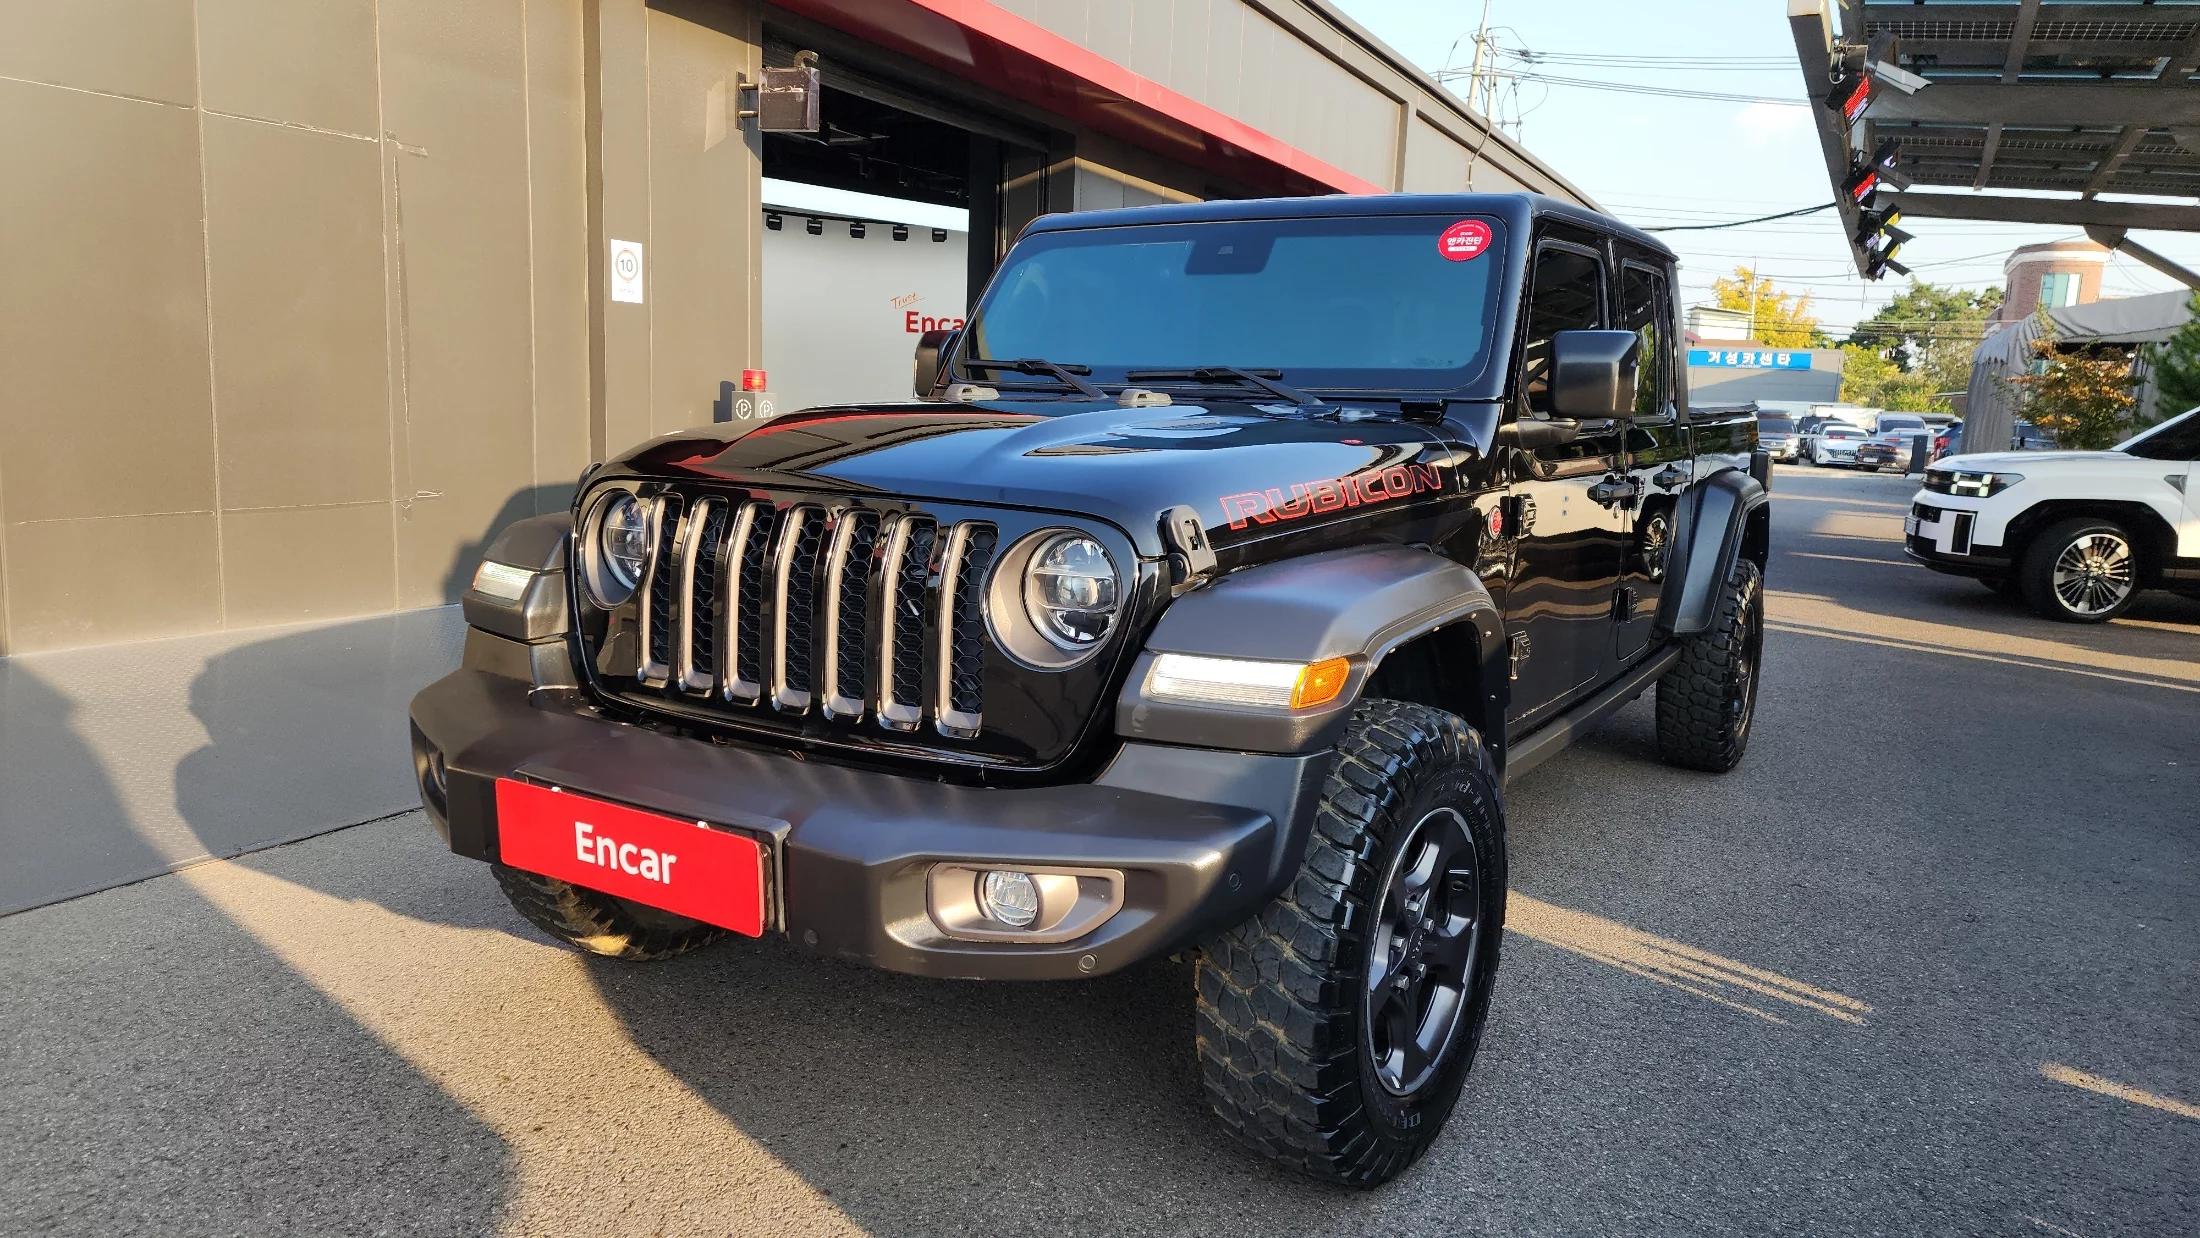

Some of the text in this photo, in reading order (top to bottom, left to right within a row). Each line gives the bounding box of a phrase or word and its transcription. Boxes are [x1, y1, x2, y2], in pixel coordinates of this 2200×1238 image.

[620, 259, 633, 272] 10
[1219, 463, 1442, 530] RUBICON
[574, 821, 678, 885] Encar
